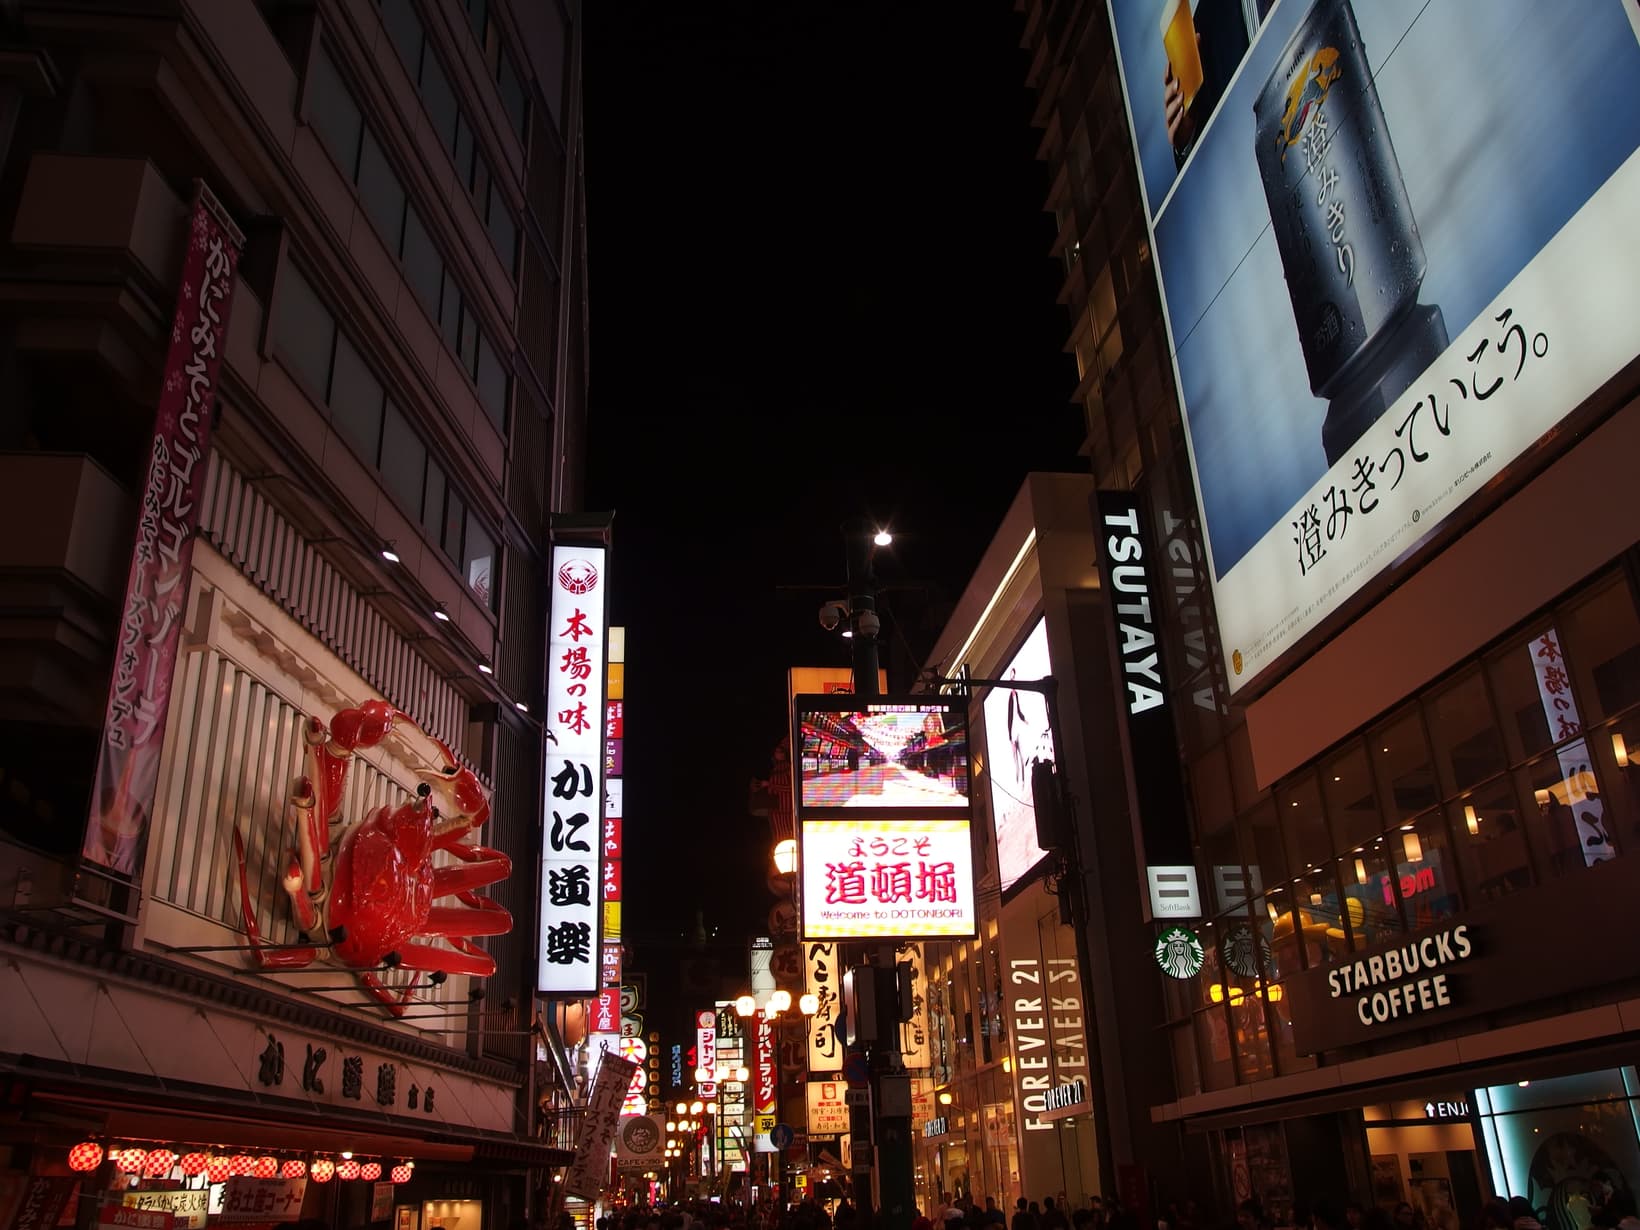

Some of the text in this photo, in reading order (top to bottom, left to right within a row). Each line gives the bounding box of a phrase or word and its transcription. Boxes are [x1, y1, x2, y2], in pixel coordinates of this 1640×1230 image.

[1302, 111, 1355, 289] 澄みきり
[1292, 308, 1549, 577] 澄みきっていこう。
[1104, 508, 1165, 715] TSUTAYA
[558, 607, 594, 736] 本場の味
[547, 759, 594, 965] かに道楽
[825, 861, 957, 904] 道頓堀
[848, 835, 932, 858] ようこそ
[820, 908, 963, 921] Welcome to DOTONBORI
[1160, 902, 1192, 913] SoftBank
[1328, 924, 1472, 999] STARBUCKS
[597, 993, 613, 1030] 白木屋
[1357, 974, 1451, 1026] COFFEE
[1010, 958, 1055, 1131] FOREVER 21
